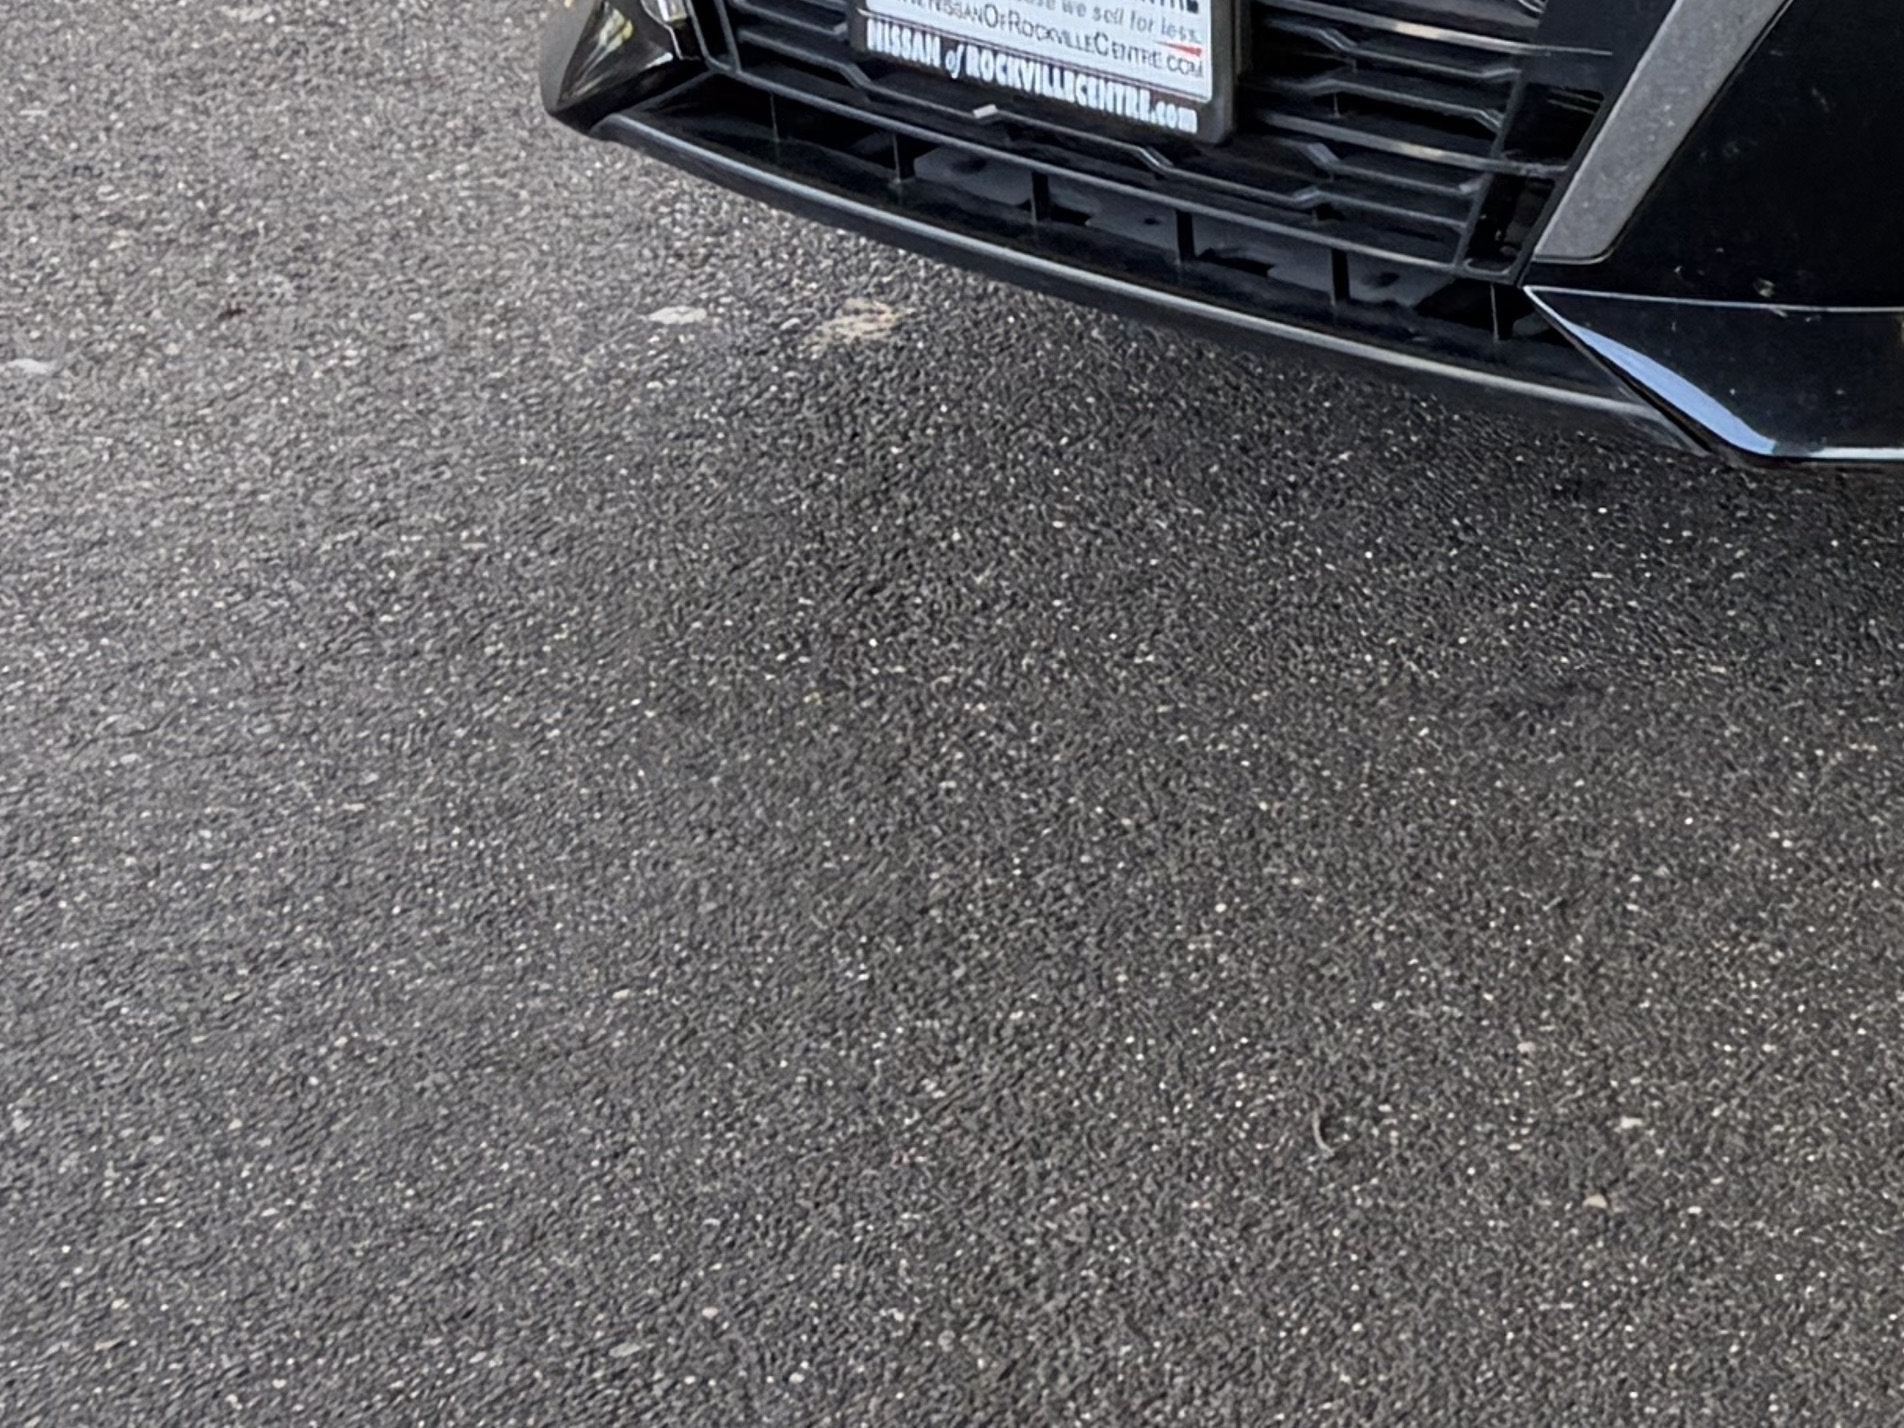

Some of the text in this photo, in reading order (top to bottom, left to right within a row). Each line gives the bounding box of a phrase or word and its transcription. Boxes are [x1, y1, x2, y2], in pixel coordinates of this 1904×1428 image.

[1093, 6, 1124, 25] sell
[1130, 10, 1154, 34] for
[867, 16, 942, 69] NISSAN
